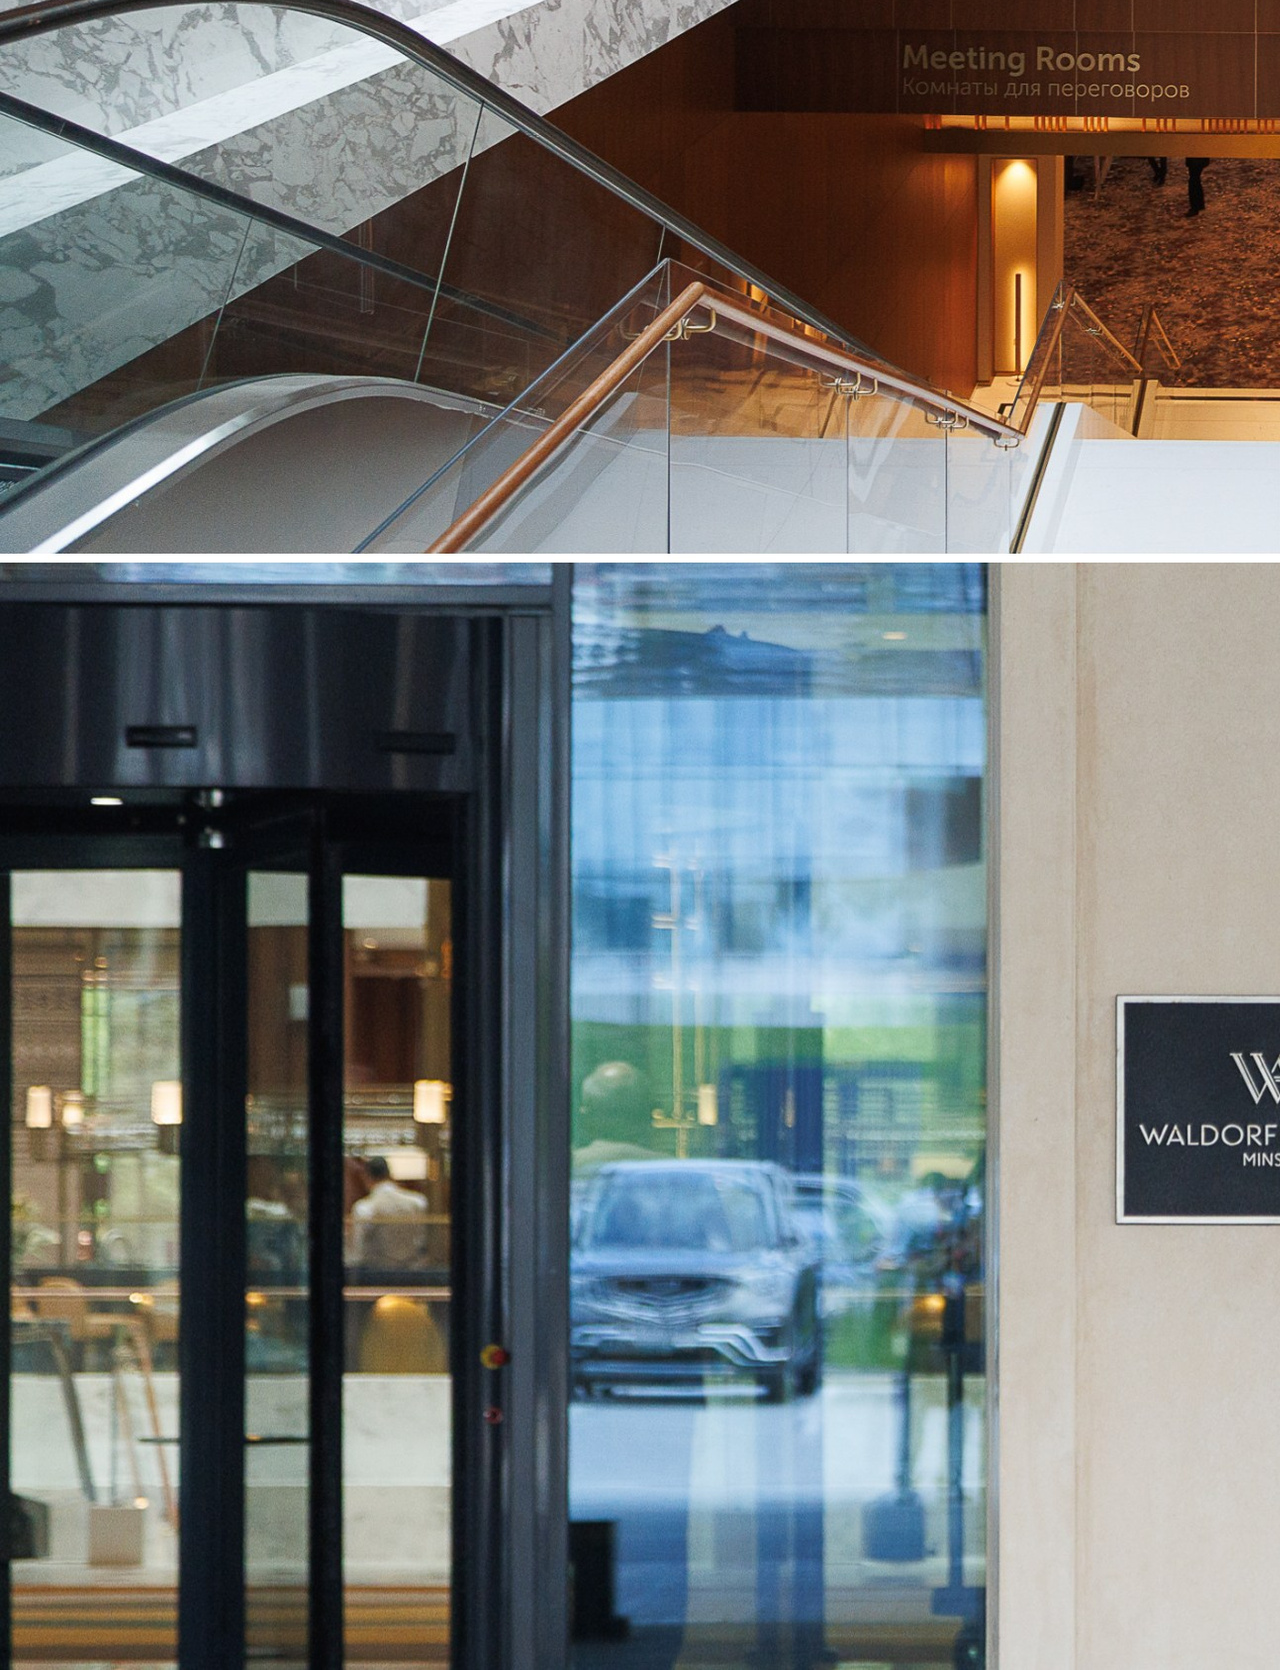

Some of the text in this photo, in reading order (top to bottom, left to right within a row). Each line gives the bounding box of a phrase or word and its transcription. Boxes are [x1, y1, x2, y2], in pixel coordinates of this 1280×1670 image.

[902, 44, 1141, 77] Meeting Rooms
[902, 77, 1190, 102] Комнаты для переговоров
[1139, 1124, 1278, 1146] WALDORF
